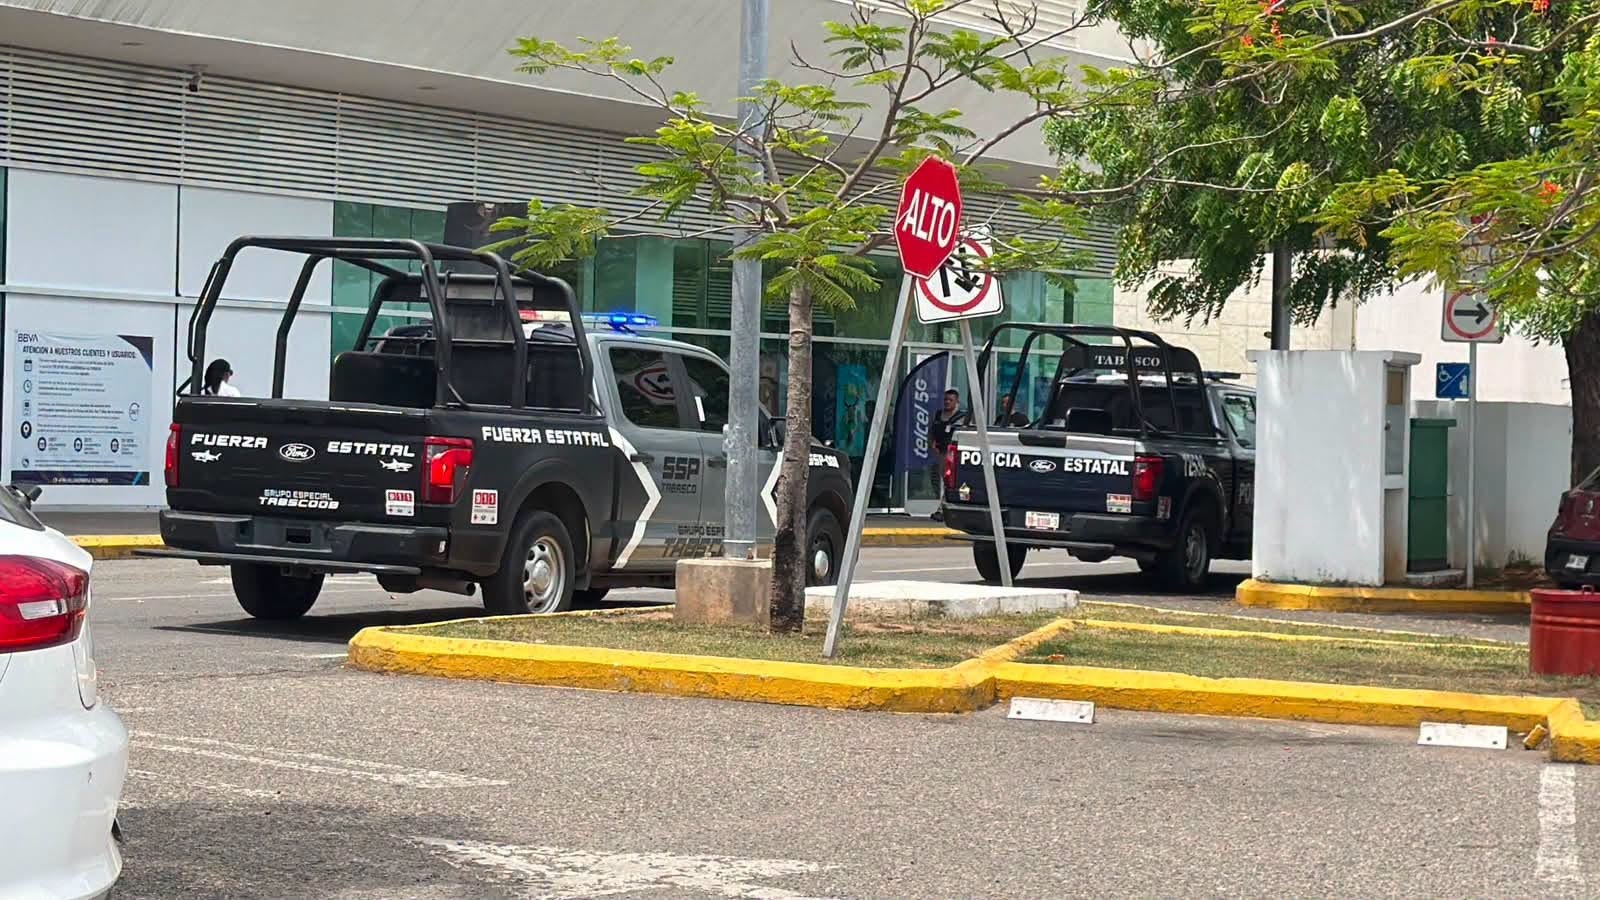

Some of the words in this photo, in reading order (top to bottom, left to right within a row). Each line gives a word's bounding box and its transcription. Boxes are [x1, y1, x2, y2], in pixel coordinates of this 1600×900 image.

[902, 188, 956, 249] ALTO
[17, 333, 39, 343] BBVA
[54, 347, 81, 356] NUESTROS
[82, 349, 105, 358] CLIENTES
[1094, 355, 1160, 367] TABSCO
[915, 378, 929, 403] 5G
[482, 426, 542, 443] FUERZA
[546, 429, 610, 448] ESTATAL
[914, 404, 929, 459] telcel
[191, 433, 268, 449] FUERZA
[282, 444, 311, 459] Ford
[327, 441, 416, 457] ESTATAL
[960, 451, 1022, 468] POICIA
[1064, 457, 1129, 475] ESTATAL
[662, 456, 700, 480] SSP
[263, 489, 291, 498] GRUPO
[293, 491, 333, 500] ESPECIAL
[661, 483, 697, 494] TABASCO
[258, 496, 339, 509] TABSCOOB
[475, 493, 496, 504] 911
[678, 525, 704, 536] GRUPO
